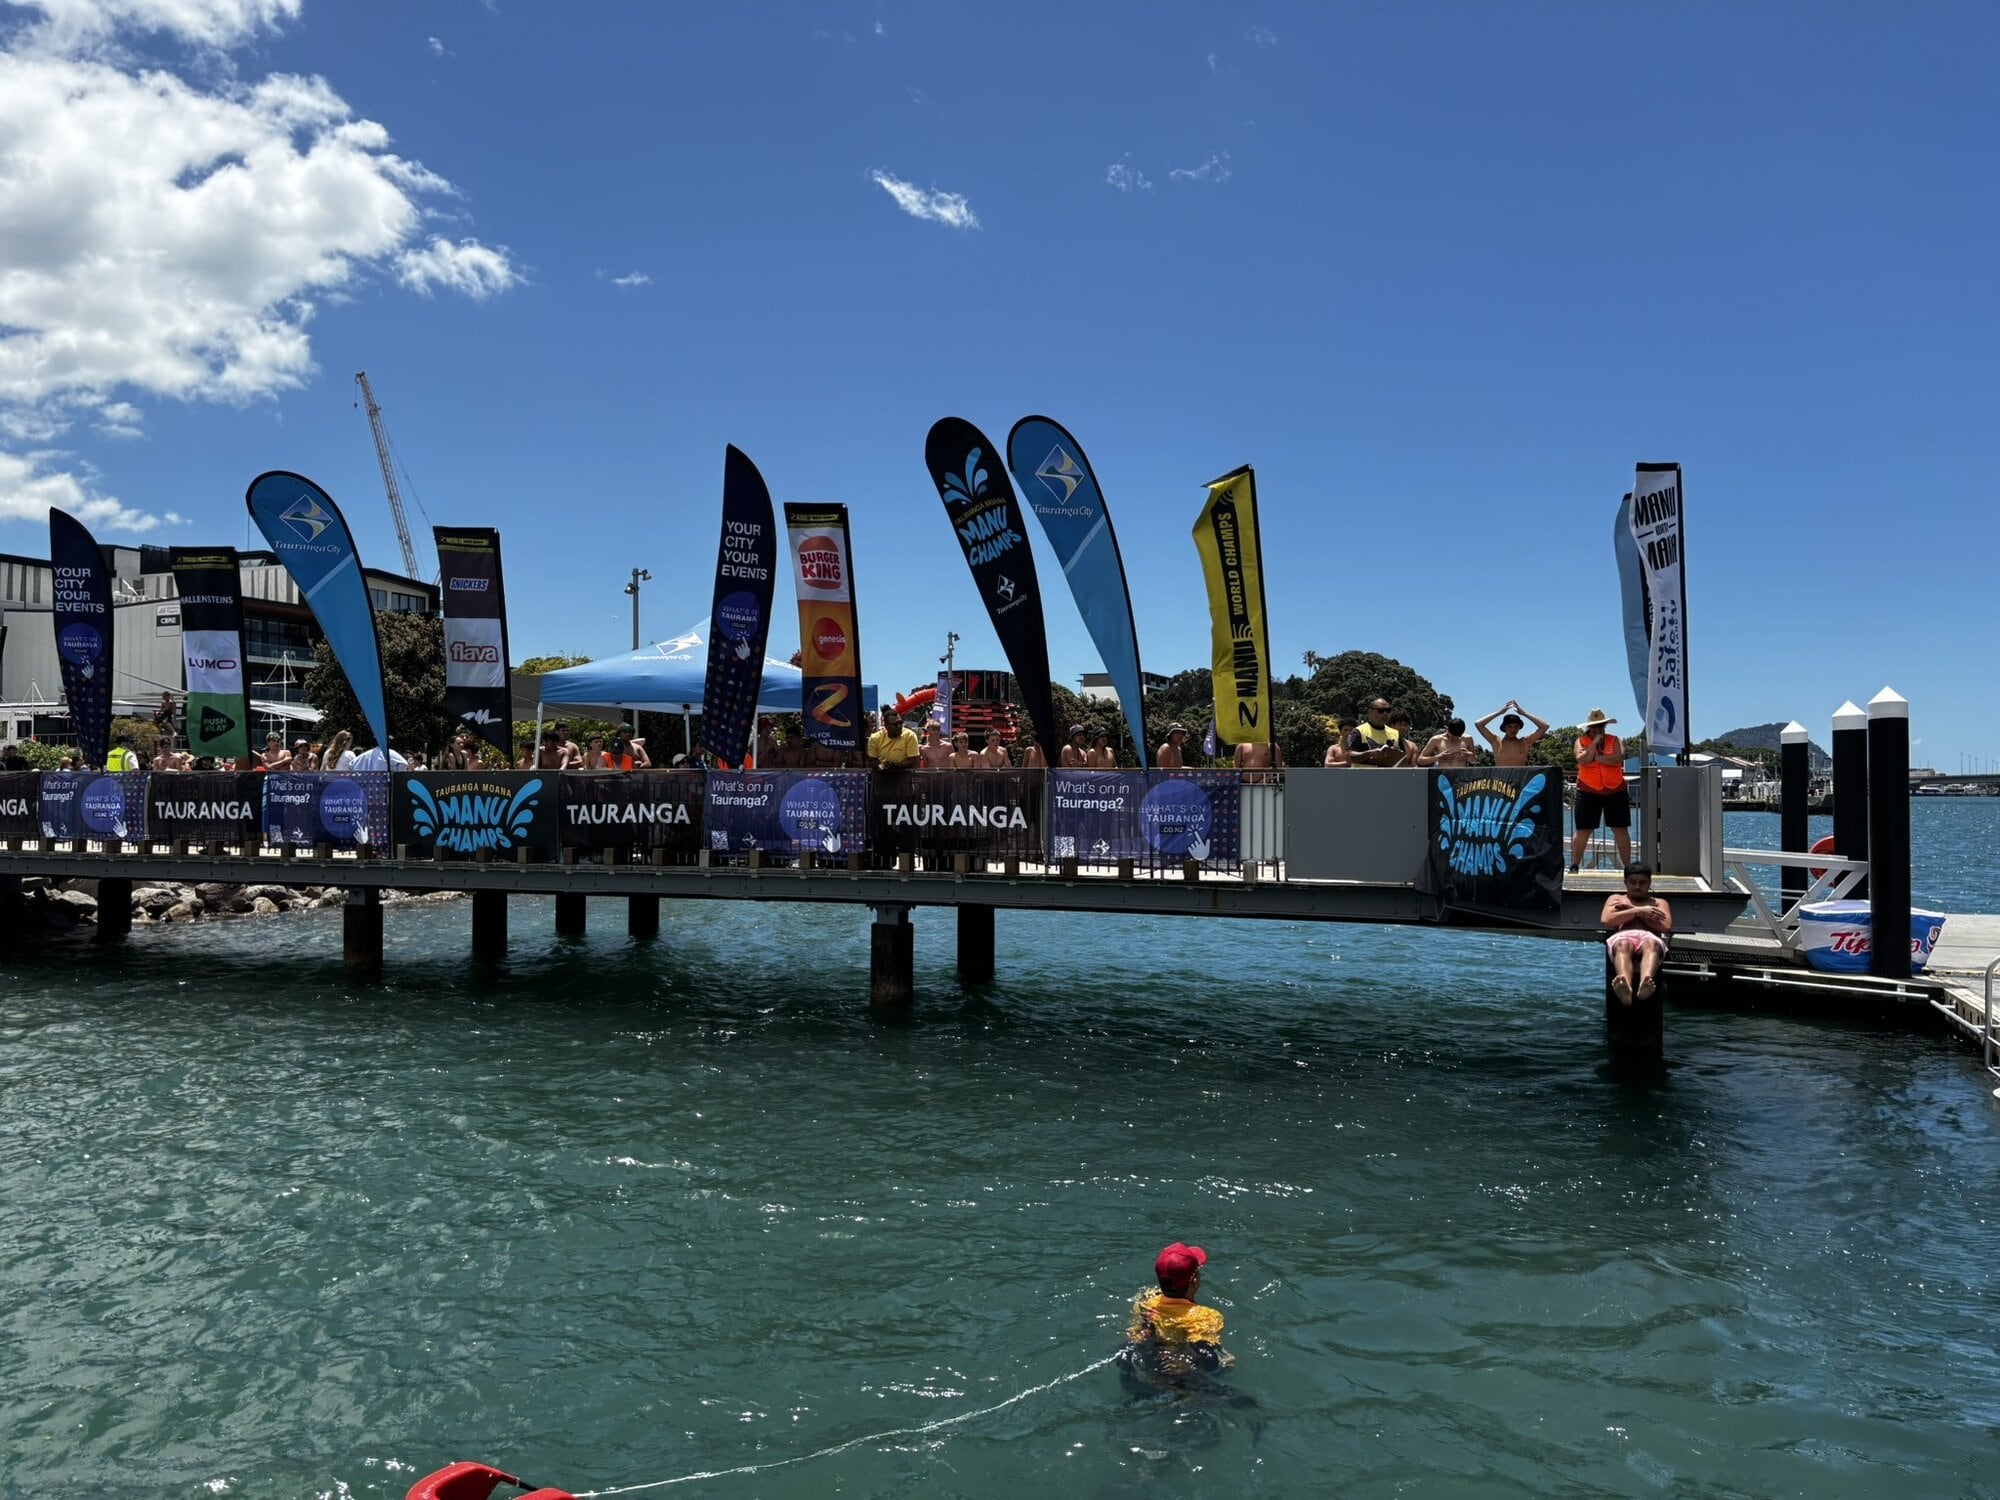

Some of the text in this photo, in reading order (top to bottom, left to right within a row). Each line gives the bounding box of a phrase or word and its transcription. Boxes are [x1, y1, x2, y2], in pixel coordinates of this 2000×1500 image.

[1032, 504, 1094, 518] Tauranga City
[1634, 486, 1677, 529] MANU
[726, 520, 761, 536] YOUR
[958, 505, 1008, 546] MANU
[725, 535, 755, 550] CITY
[1217, 511, 1238, 566] CHAMPS
[273, 540, 342, 554] Tauranga City
[969, 528, 1022, 567] CHAMPS
[724, 549, 759, 565] YOUR
[800, 551, 840, 565] BURGER
[54, 567, 91, 578] YOUR
[721, 564, 768, 580] EVENTS
[801, 563, 841, 581] KING
[55, 579, 85, 589] CITY
[450, 578, 488, 590] SNICKERS
[55, 590, 91, 601] YOUR
[1227, 569, 1244, 616] WORLD
[55, 602, 105, 613] EVENTS
[818, 634, 846, 644] genesis
[451, 642, 498, 662] flava
[188, 657, 237, 669] LUMO
[1233, 640, 1259, 698] MANU
[203, 717, 227, 725] PUSH
[205, 724, 228, 732] PLAY
[270, 780, 314, 791] What's on in
[435, 783, 512, 798] TAURANGA MOANA
[712, 780, 774, 792] What's on in
[1056, 780, 1130, 795] What's on in
[1456, 778, 1516, 800] TAURANGA MOANA
[42, 791, 74, 802] Tauranga?
[270, 792, 310, 805] Tauranga?
[324, 798, 363, 806] WHAT'S ON
[710, 794, 768, 808] Tauranga?
[155, 801, 254, 820] TAURANGA
[324, 806, 363, 814] TAURANGA
[437, 794, 509, 825] MANU
[786, 801, 835, 810] WHAT'S ON
[1055, 796, 1124, 812] Tauranga?
[1147, 804, 1206, 813] WHAT'S ON
[566, 803, 691, 825] TAURANGA
[786, 809, 835, 818] TAURANGA
[882, 804, 1028, 829] TAURANGA
[1146, 814, 1205, 823] TAURANGA
[1457, 795, 1512, 839] MANU
[435, 827, 512, 852] CHAMPS
[1449, 839, 1507, 876] CHAMPS
